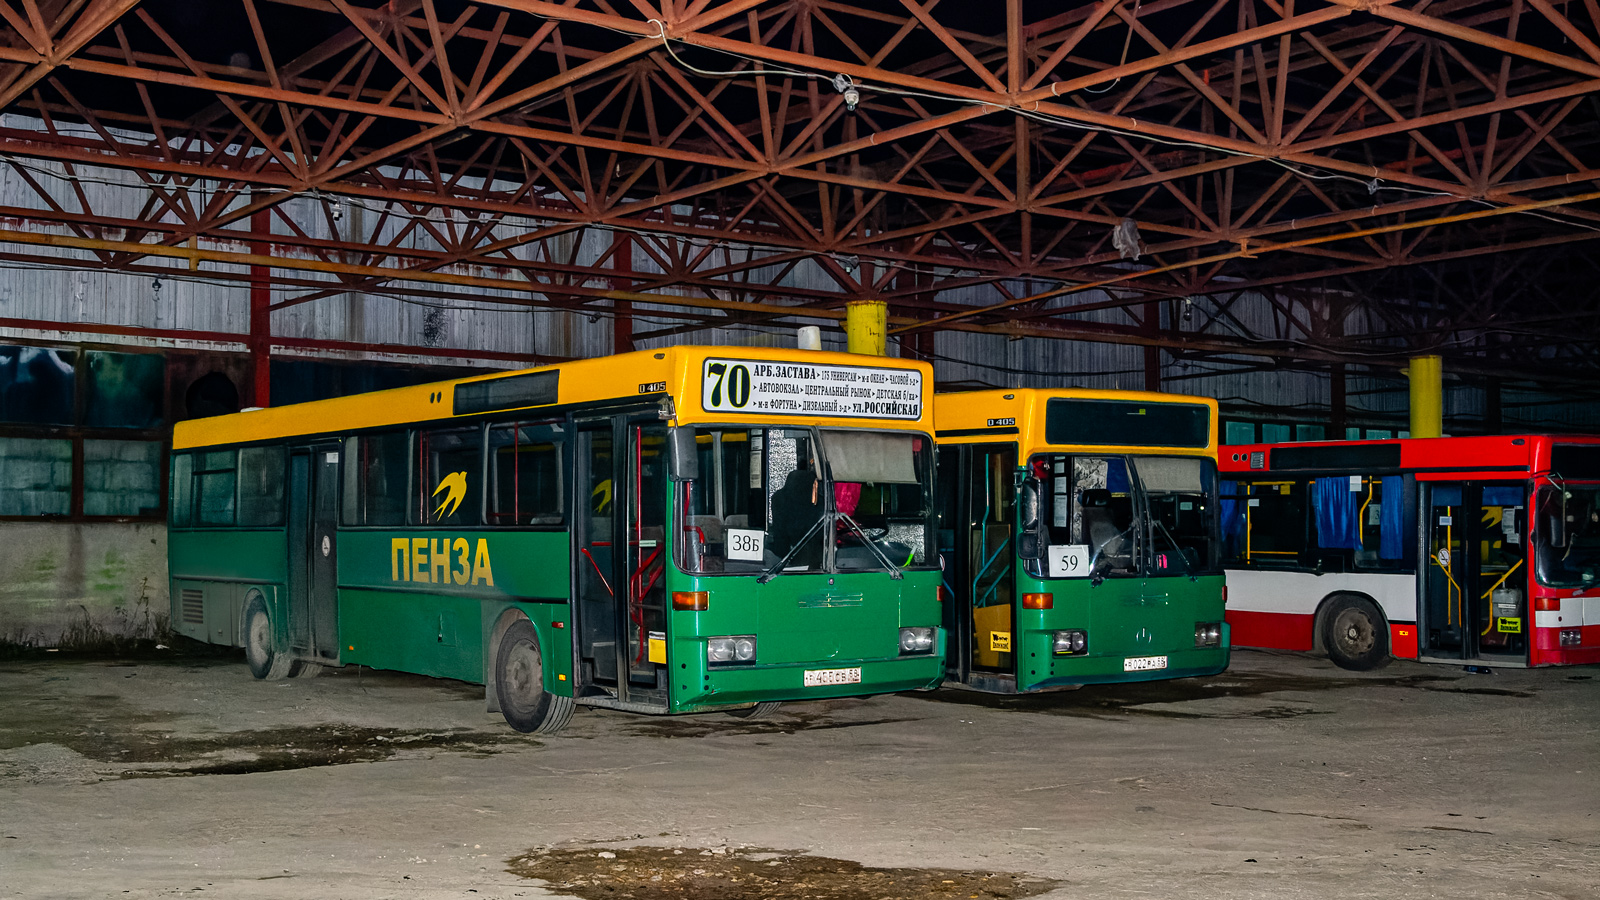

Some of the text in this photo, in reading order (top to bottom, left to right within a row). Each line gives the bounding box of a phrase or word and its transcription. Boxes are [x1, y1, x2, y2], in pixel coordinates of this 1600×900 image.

[753, 364, 816, 379] АРБ.ЗАСТАВА
[647, 382, 666, 392] 405
[707, 363, 751, 408] 70
[759, 382, 800, 394] АВТОВОКЗАЛ
[804, 384, 849, 397] ЦЕНТРАЛЬНЫЙ
[850, 387, 872, 398] РЫНОК
[876, 389, 902, 400] ДЕТСКАЯ
[769, 398, 798, 410] ФОРТУНА
[802, 399, 838, 412] ДИЗЕЛЬНЫЙ
[995, 418, 1015, 426] 405
[732, 534, 760, 552] 38Б
[391, 537, 494, 587] ПЕНЗА
[1061, 554, 1079, 571] 59
